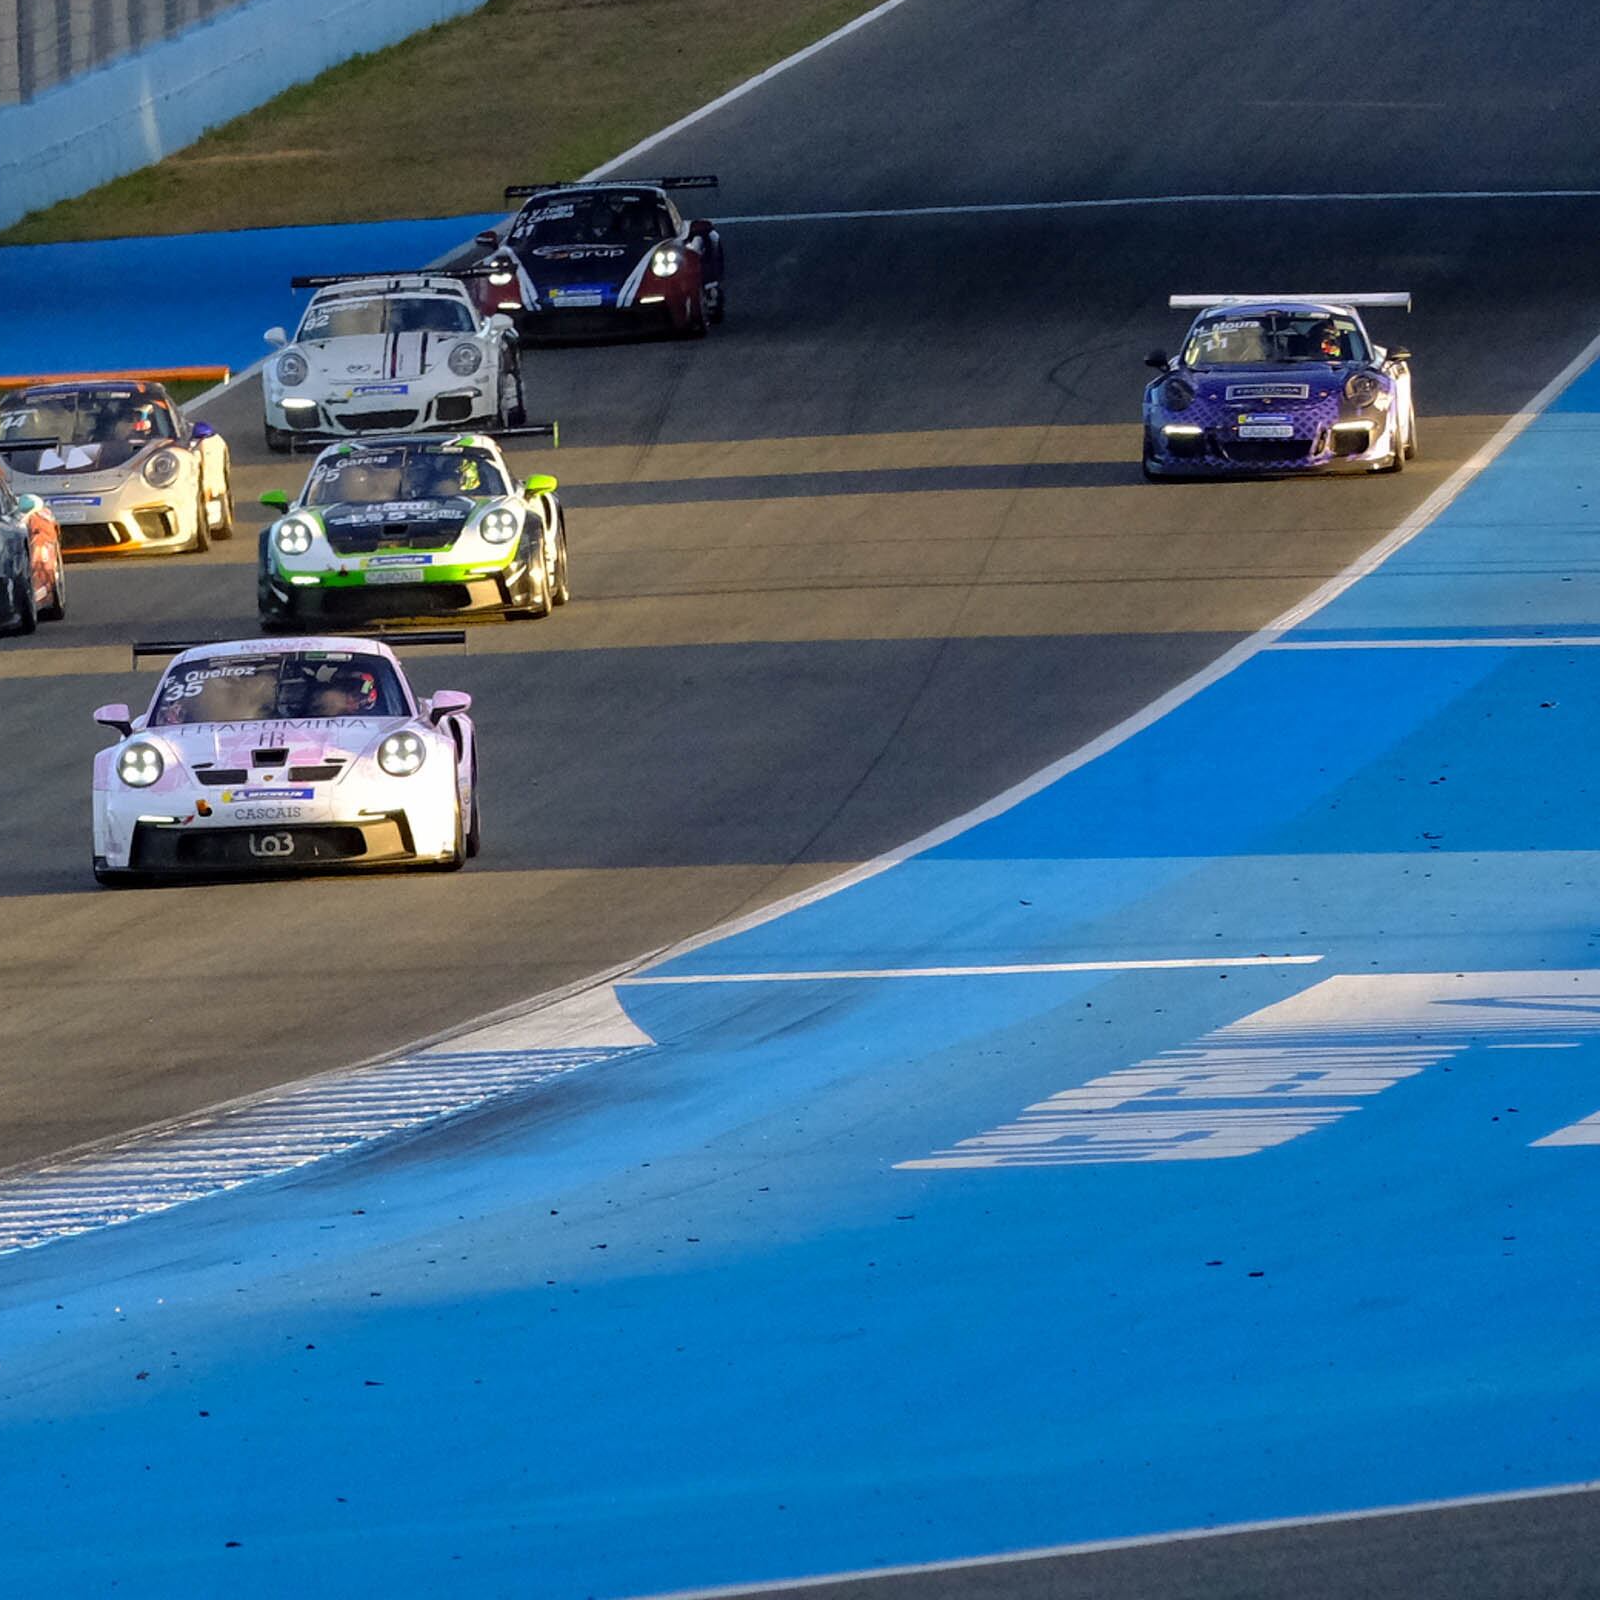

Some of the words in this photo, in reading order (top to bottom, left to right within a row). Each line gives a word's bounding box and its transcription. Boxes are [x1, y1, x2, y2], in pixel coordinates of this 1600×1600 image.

[185, 666, 257, 682] Queiroz
[165, 681, 205, 701] 35
[234, 807, 302, 820] CASCAIS
